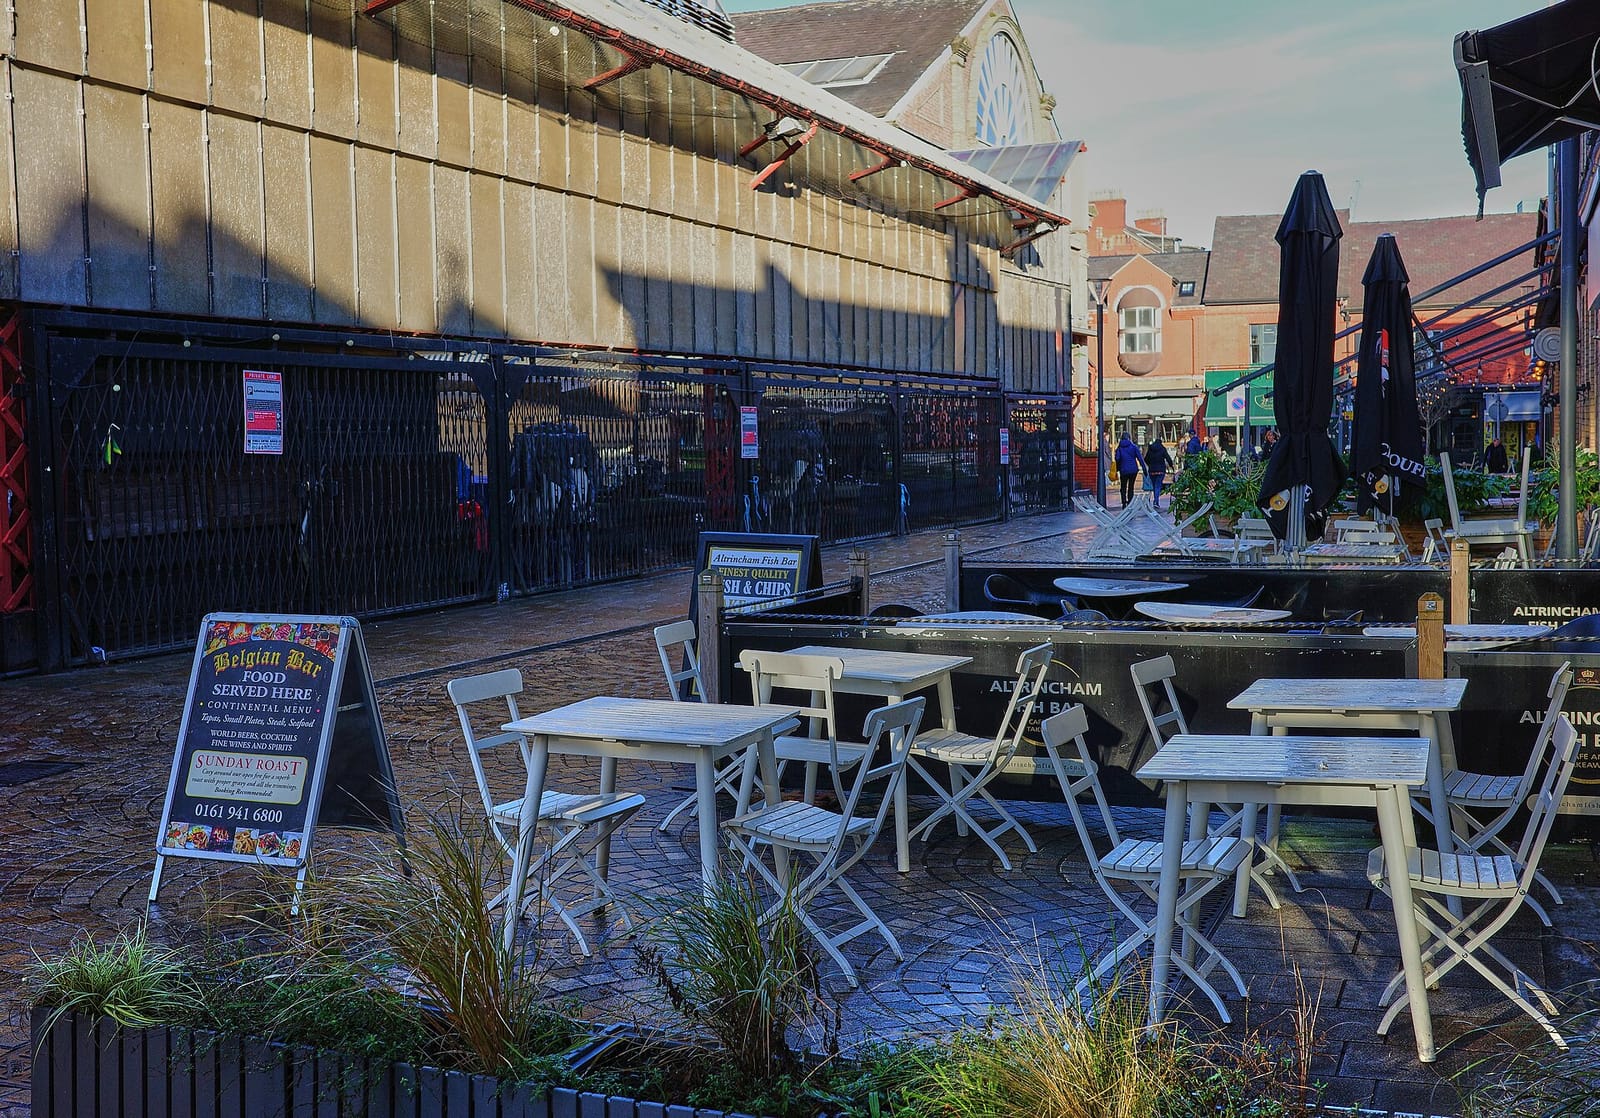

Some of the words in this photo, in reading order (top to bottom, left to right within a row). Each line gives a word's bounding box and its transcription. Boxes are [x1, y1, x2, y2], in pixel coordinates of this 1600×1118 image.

[713, 553, 760, 564] Altrincham
[761, 555, 779, 565] Fish
[782, 557, 798, 566] Bar
[751, 569, 790, 579] QUALITY
[722, 579, 741, 594] SH
[743, 580, 753, 595] &
[755, 581, 791, 597] CHIPS
[213, 648, 281, 676] Belgian
[285, 649, 322, 678] Bar
[242, 670, 287, 684] FOOD
[212, 684, 268, 698] SERVED
[271, 687, 313, 700] HERE
[208, 701, 279, 712] CONTINENTAL
[283, 704, 312, 714] MENU
[202, 713, 221, 723] Tapas,
[223, 714, 243, 724] Small
[243, 715, 265, 726] Plates,
[266, 716, 287, 728] Steak,
[288, 718, 315, 729] Seafood
[210, 729, 237, 738] WORLD
[237, 731, 259, 740] BEERS,
[260, 733, 298, 742] COCKTAILS
[211, 739, 228, 747] FINE
[229, 740, 251, 749] WINES
[251, 742, 268, 750] AND
[268, 743, 293, 752] SPIRITS
[195, 754, 254, 769] SUNDAY
[256, 759, 302, 776] ROAST
[214, 787, 235, 795] Booking
[195, 803, 225, 819] 0161
[227, 806, 249, 821] 941
[253, 808, 283, 823] 6800
